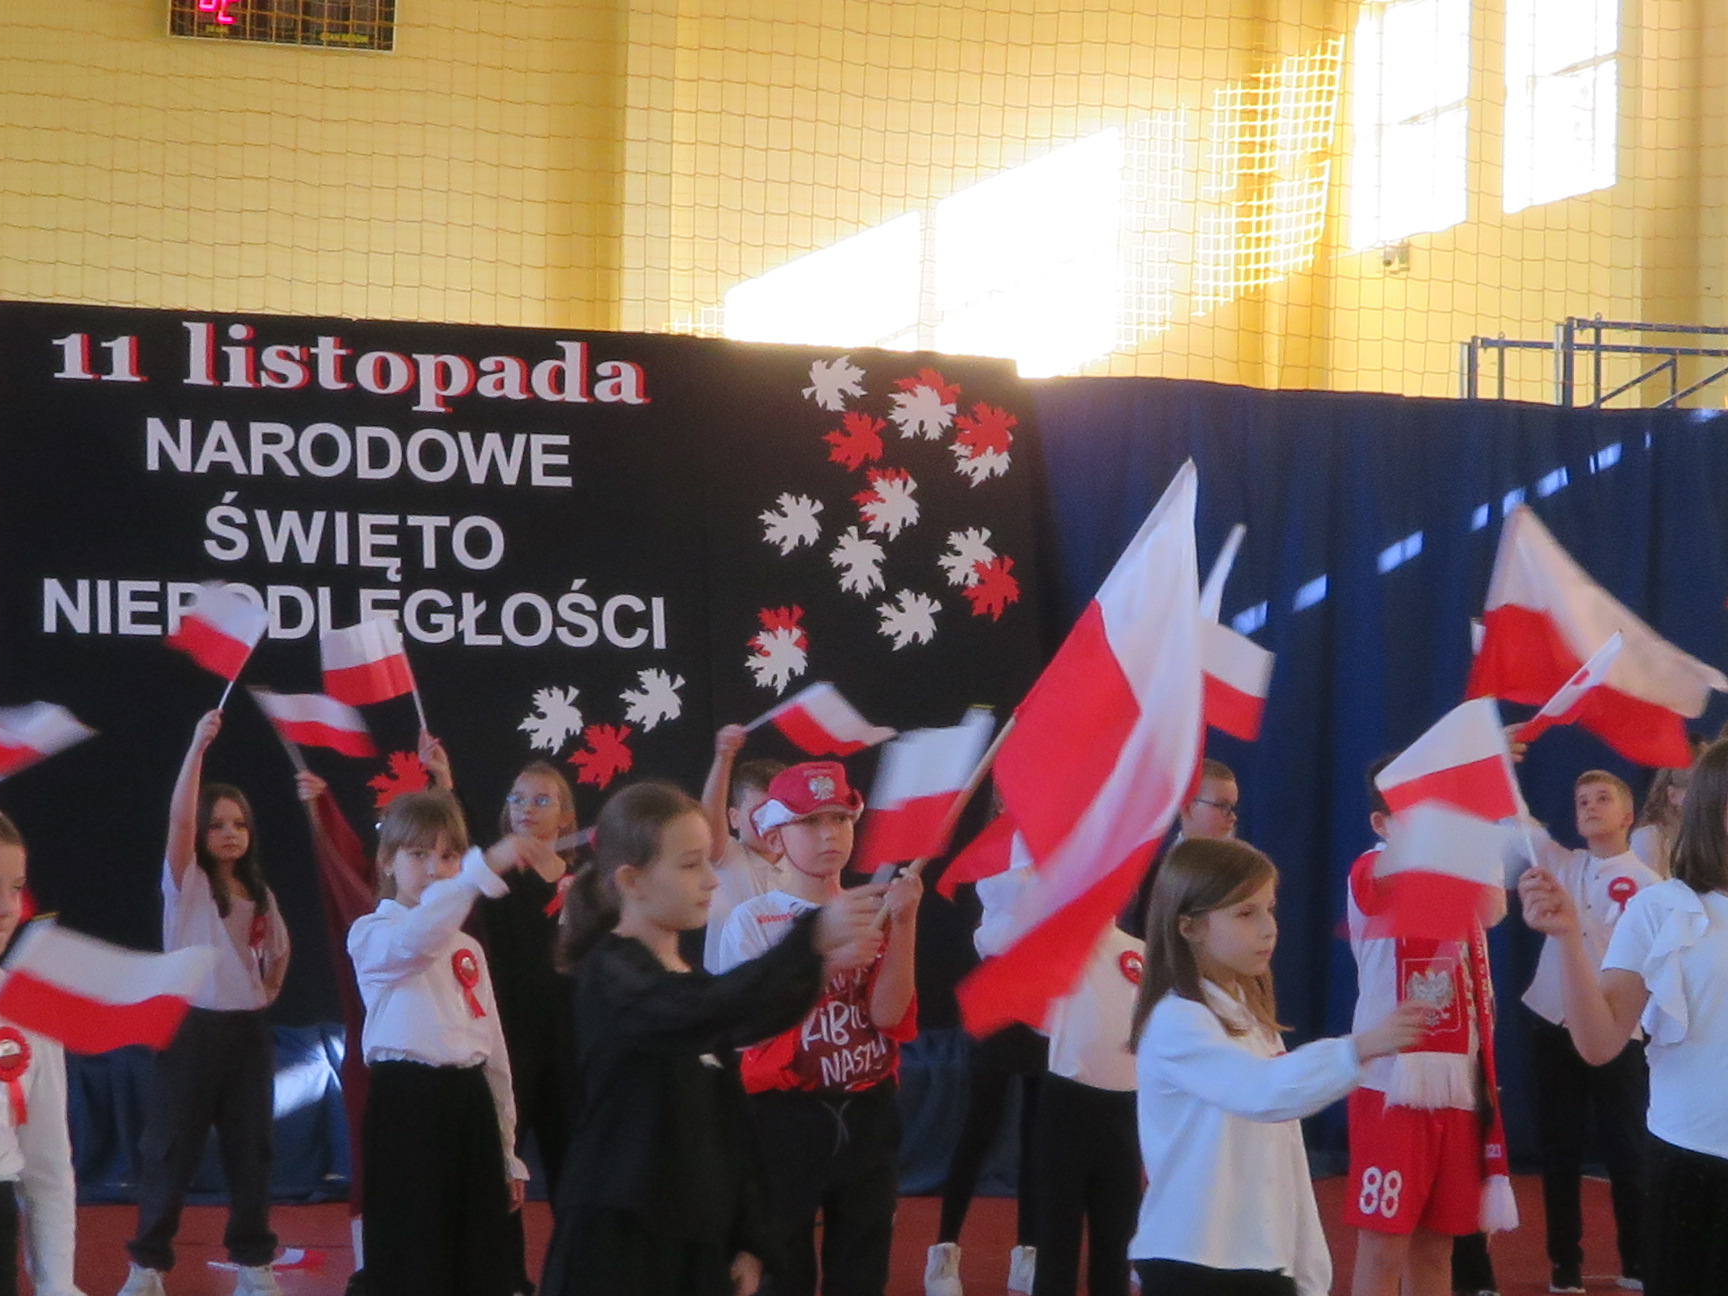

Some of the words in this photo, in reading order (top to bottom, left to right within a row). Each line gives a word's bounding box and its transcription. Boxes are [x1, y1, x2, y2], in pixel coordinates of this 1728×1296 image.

[51, 333, 149, 381] 11
[182, 321, 652, 412] listopada
[146, 417, 572, 487] NARODOWE
[203, 491, 505, 582] ŚWIĘTO
[1359, 1166, 1402, 1218] 88
